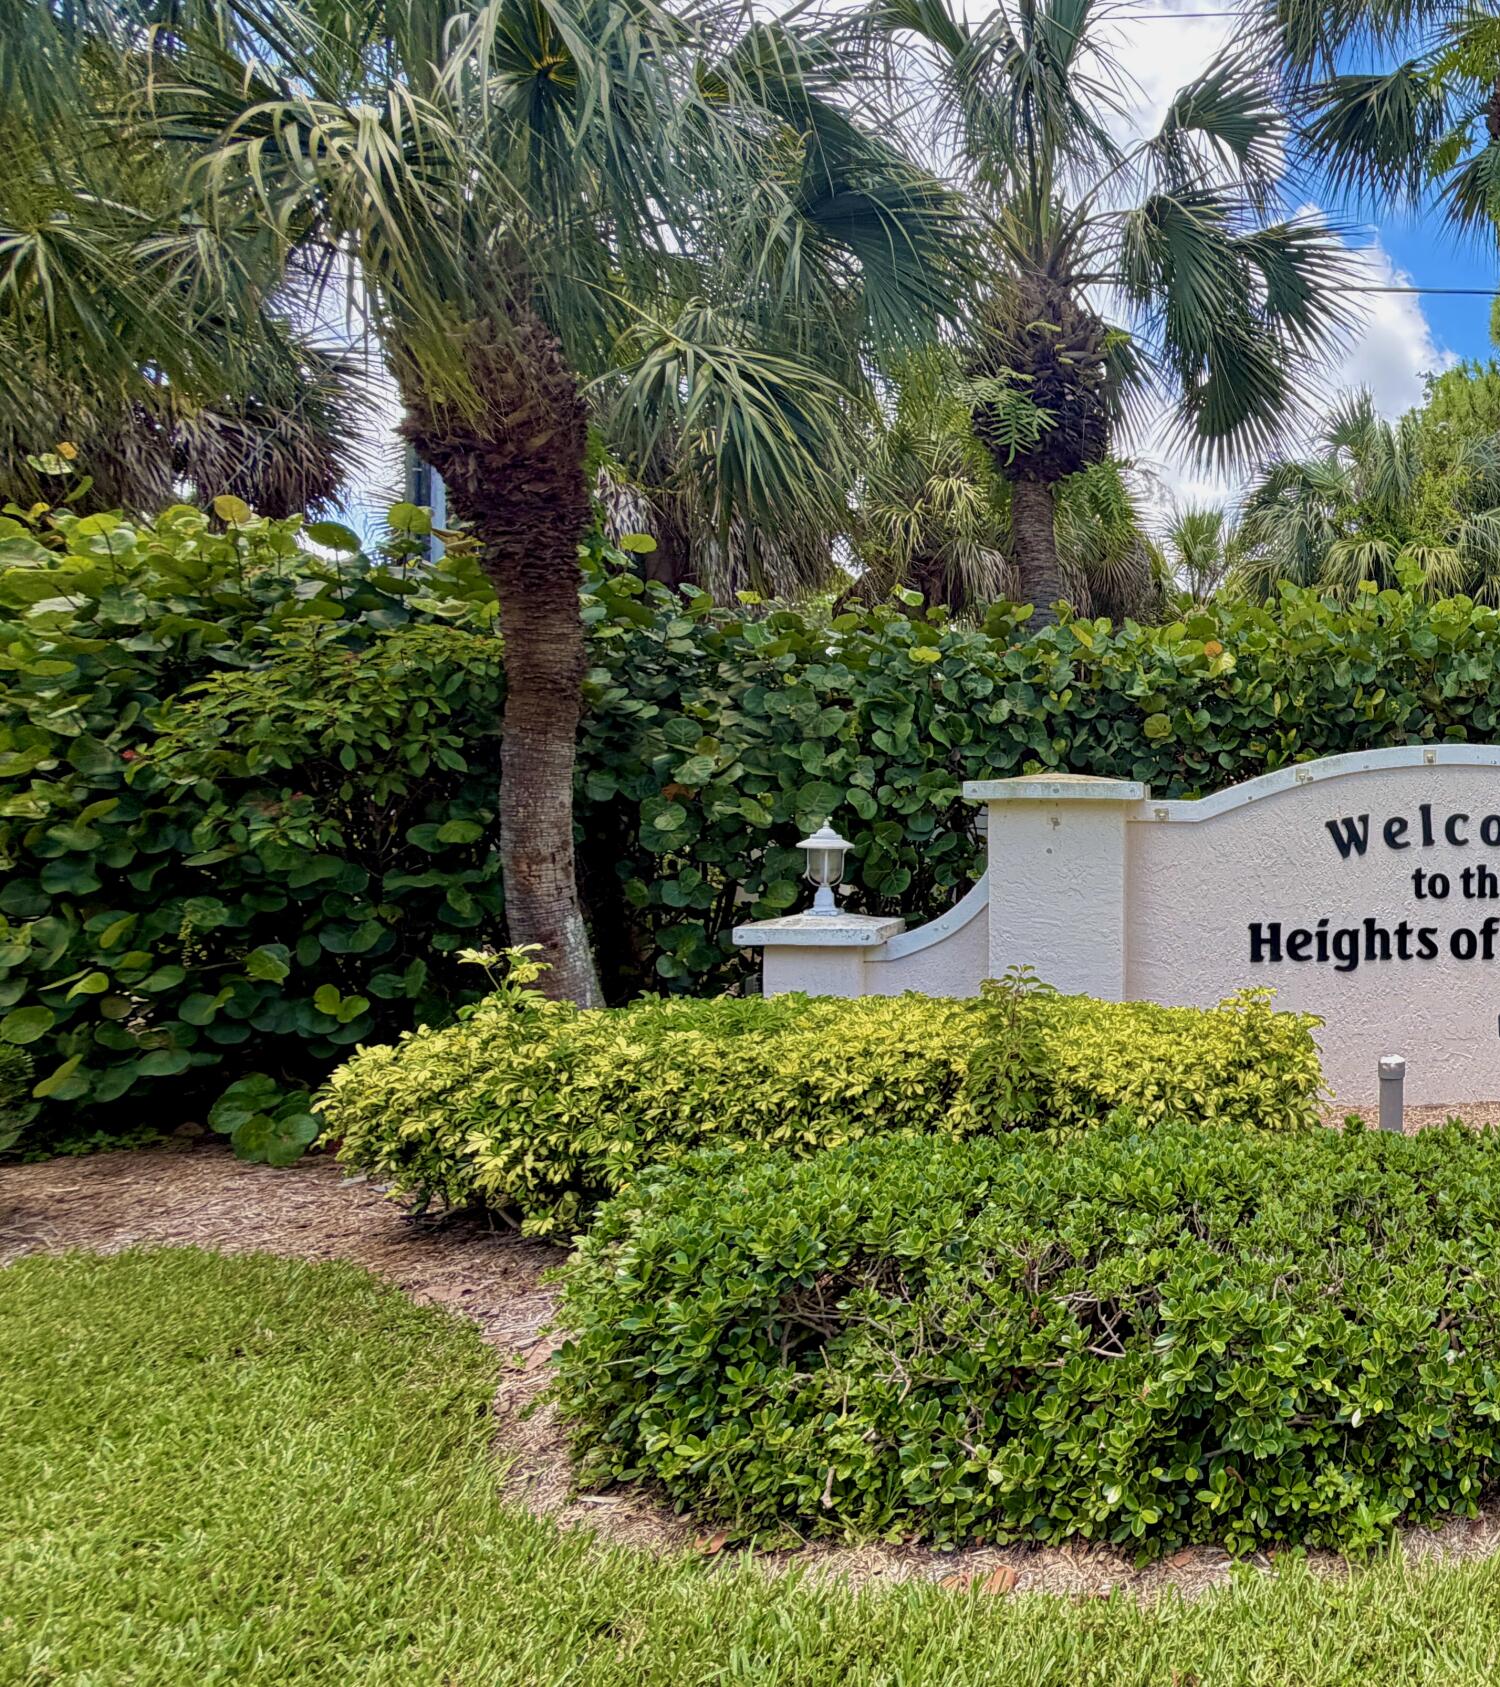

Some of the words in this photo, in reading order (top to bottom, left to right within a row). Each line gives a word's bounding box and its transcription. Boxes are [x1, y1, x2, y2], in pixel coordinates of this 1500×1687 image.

[1411, 867, 1450, 900] to
[1247, 917, 1439, 973] Heights
[1449, 916, 1500, 961] of
